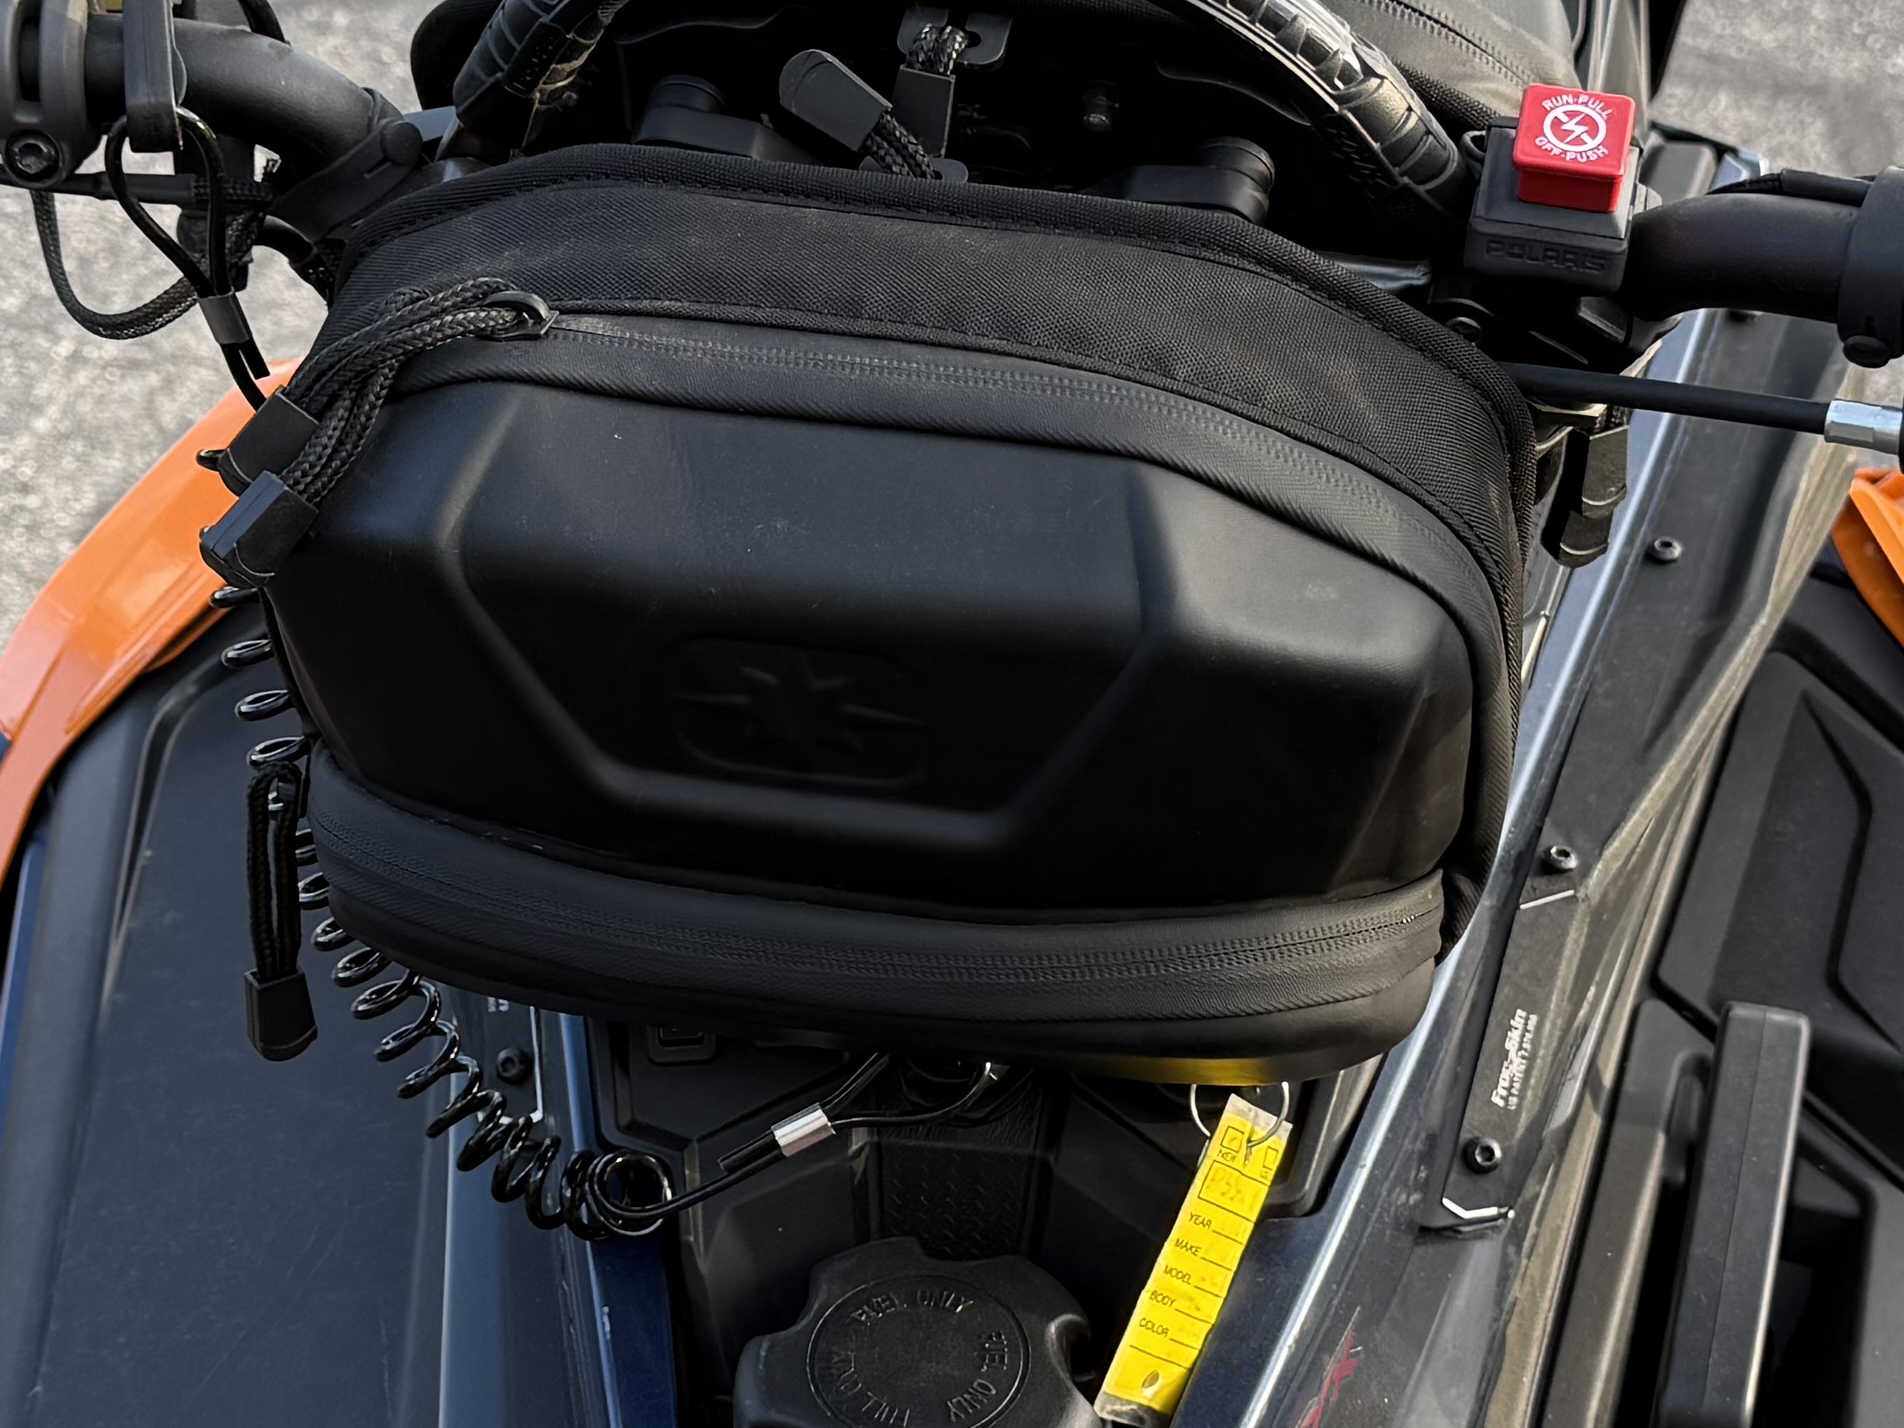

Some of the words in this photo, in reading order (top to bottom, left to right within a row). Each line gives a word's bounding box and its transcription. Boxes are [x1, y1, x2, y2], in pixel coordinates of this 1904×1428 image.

[1484, 238, 1606, 273] POLARIS
[1189, 1212, 1213, 1229] YEAR
[1174, 1237, 1202, 1257] MAKE
[1163, 1264, 1192, 1286] MODEL
[1149, 1289, 1176, 1309] BODY
[1138, 1317, 1170, 1338] COLOR
[946, 1377, 997, 1423] ONLY
